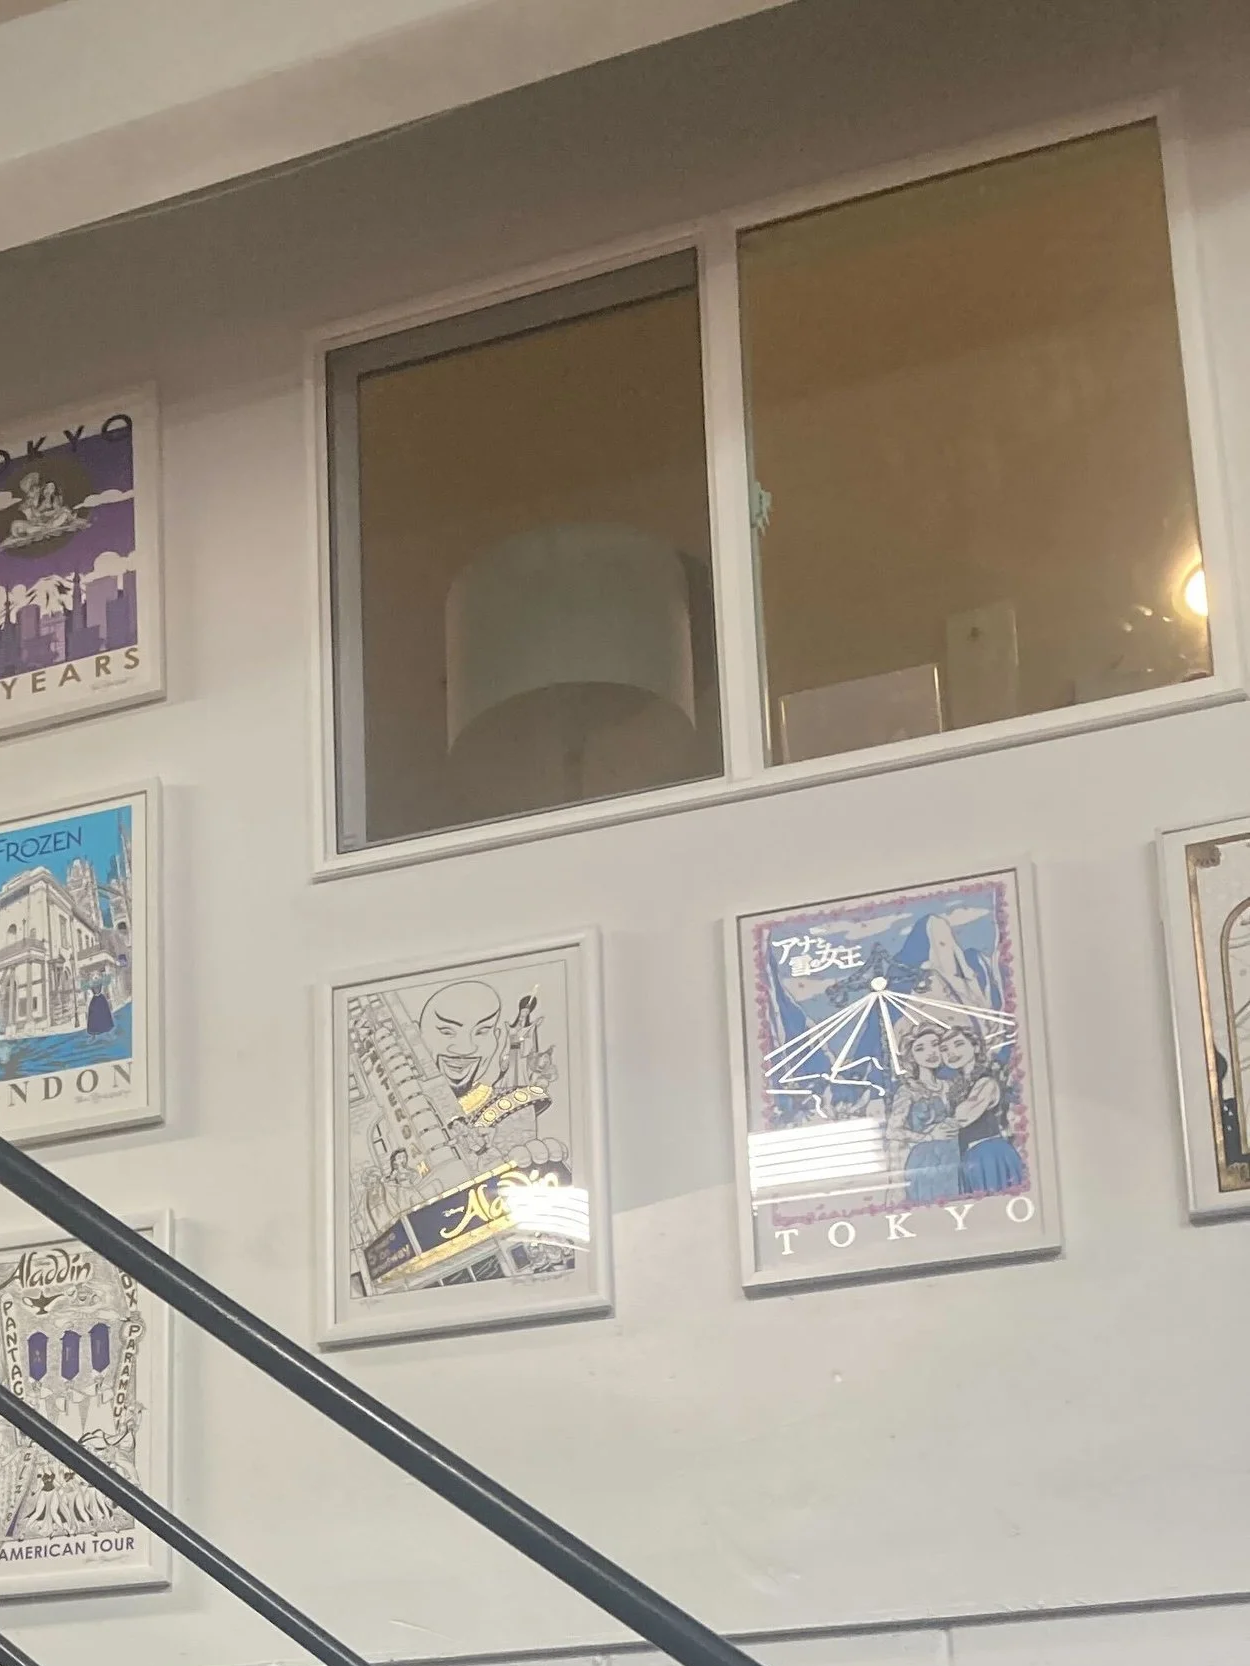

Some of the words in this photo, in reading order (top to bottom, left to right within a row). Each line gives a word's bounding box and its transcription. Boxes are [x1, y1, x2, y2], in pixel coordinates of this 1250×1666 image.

[0, 647, 140, 701] YEARS
[774, 1196, 1035, 1256] TOKYO
[119, 1268, 139, 1309] OX
[91, 1536, 135, 1554] TOUR
